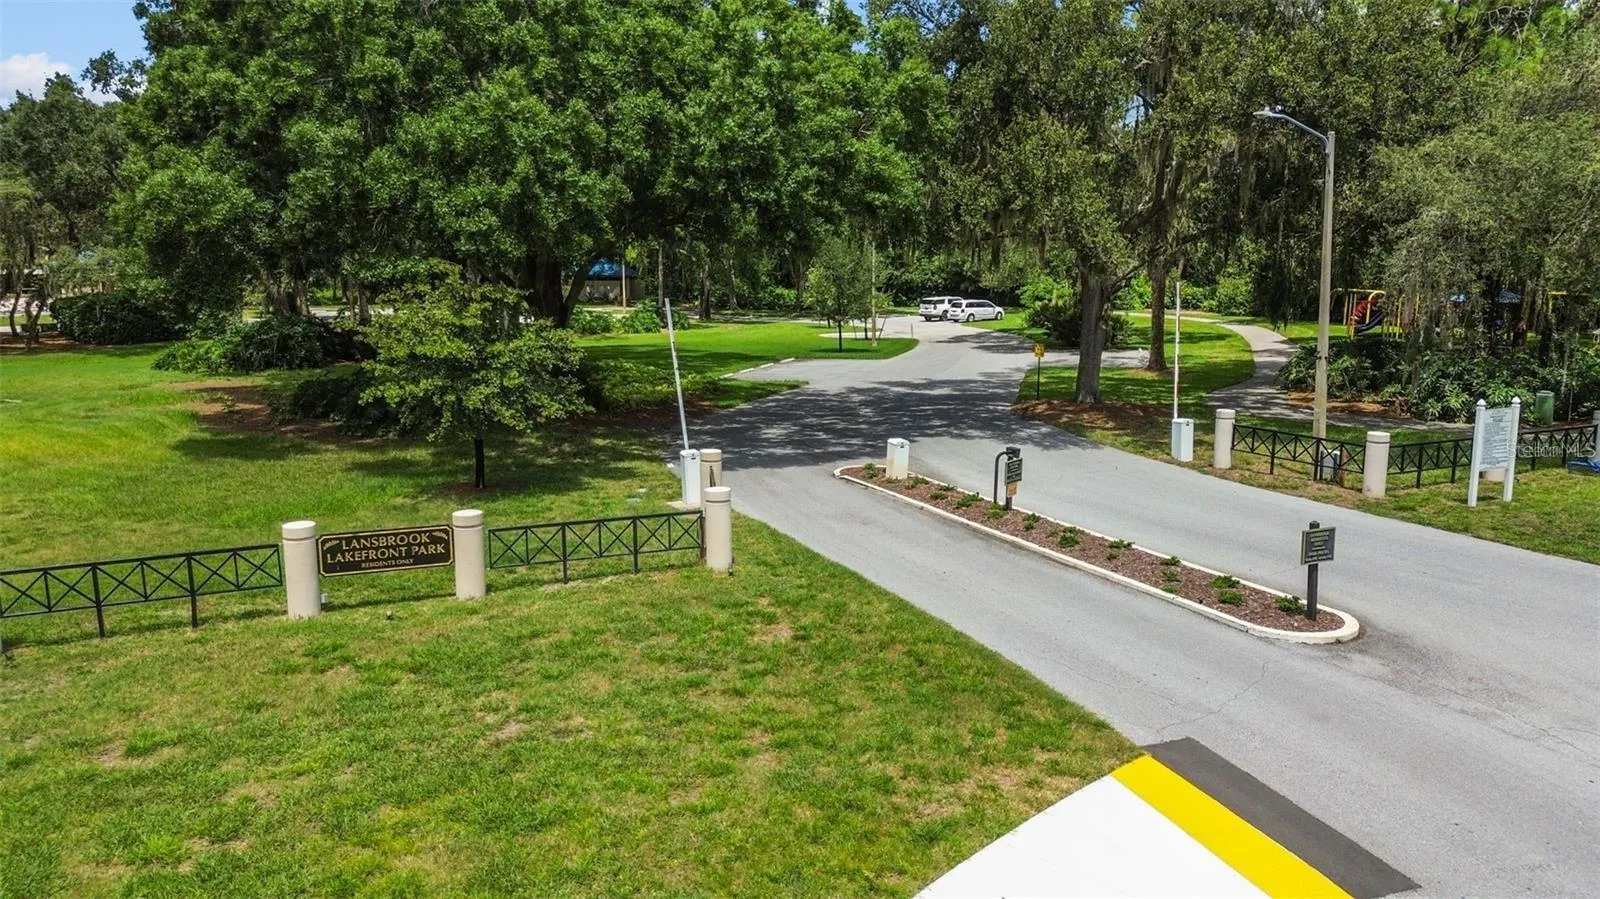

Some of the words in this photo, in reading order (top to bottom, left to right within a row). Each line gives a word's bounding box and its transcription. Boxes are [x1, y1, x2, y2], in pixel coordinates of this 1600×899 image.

[342, 532, 430, 550] LANSBROOK
[327, 546, 408, 563] LAKEFRONT
[411, 543, 445, 555] PARK
[361, 560, 396, 568] RESIDENTS
